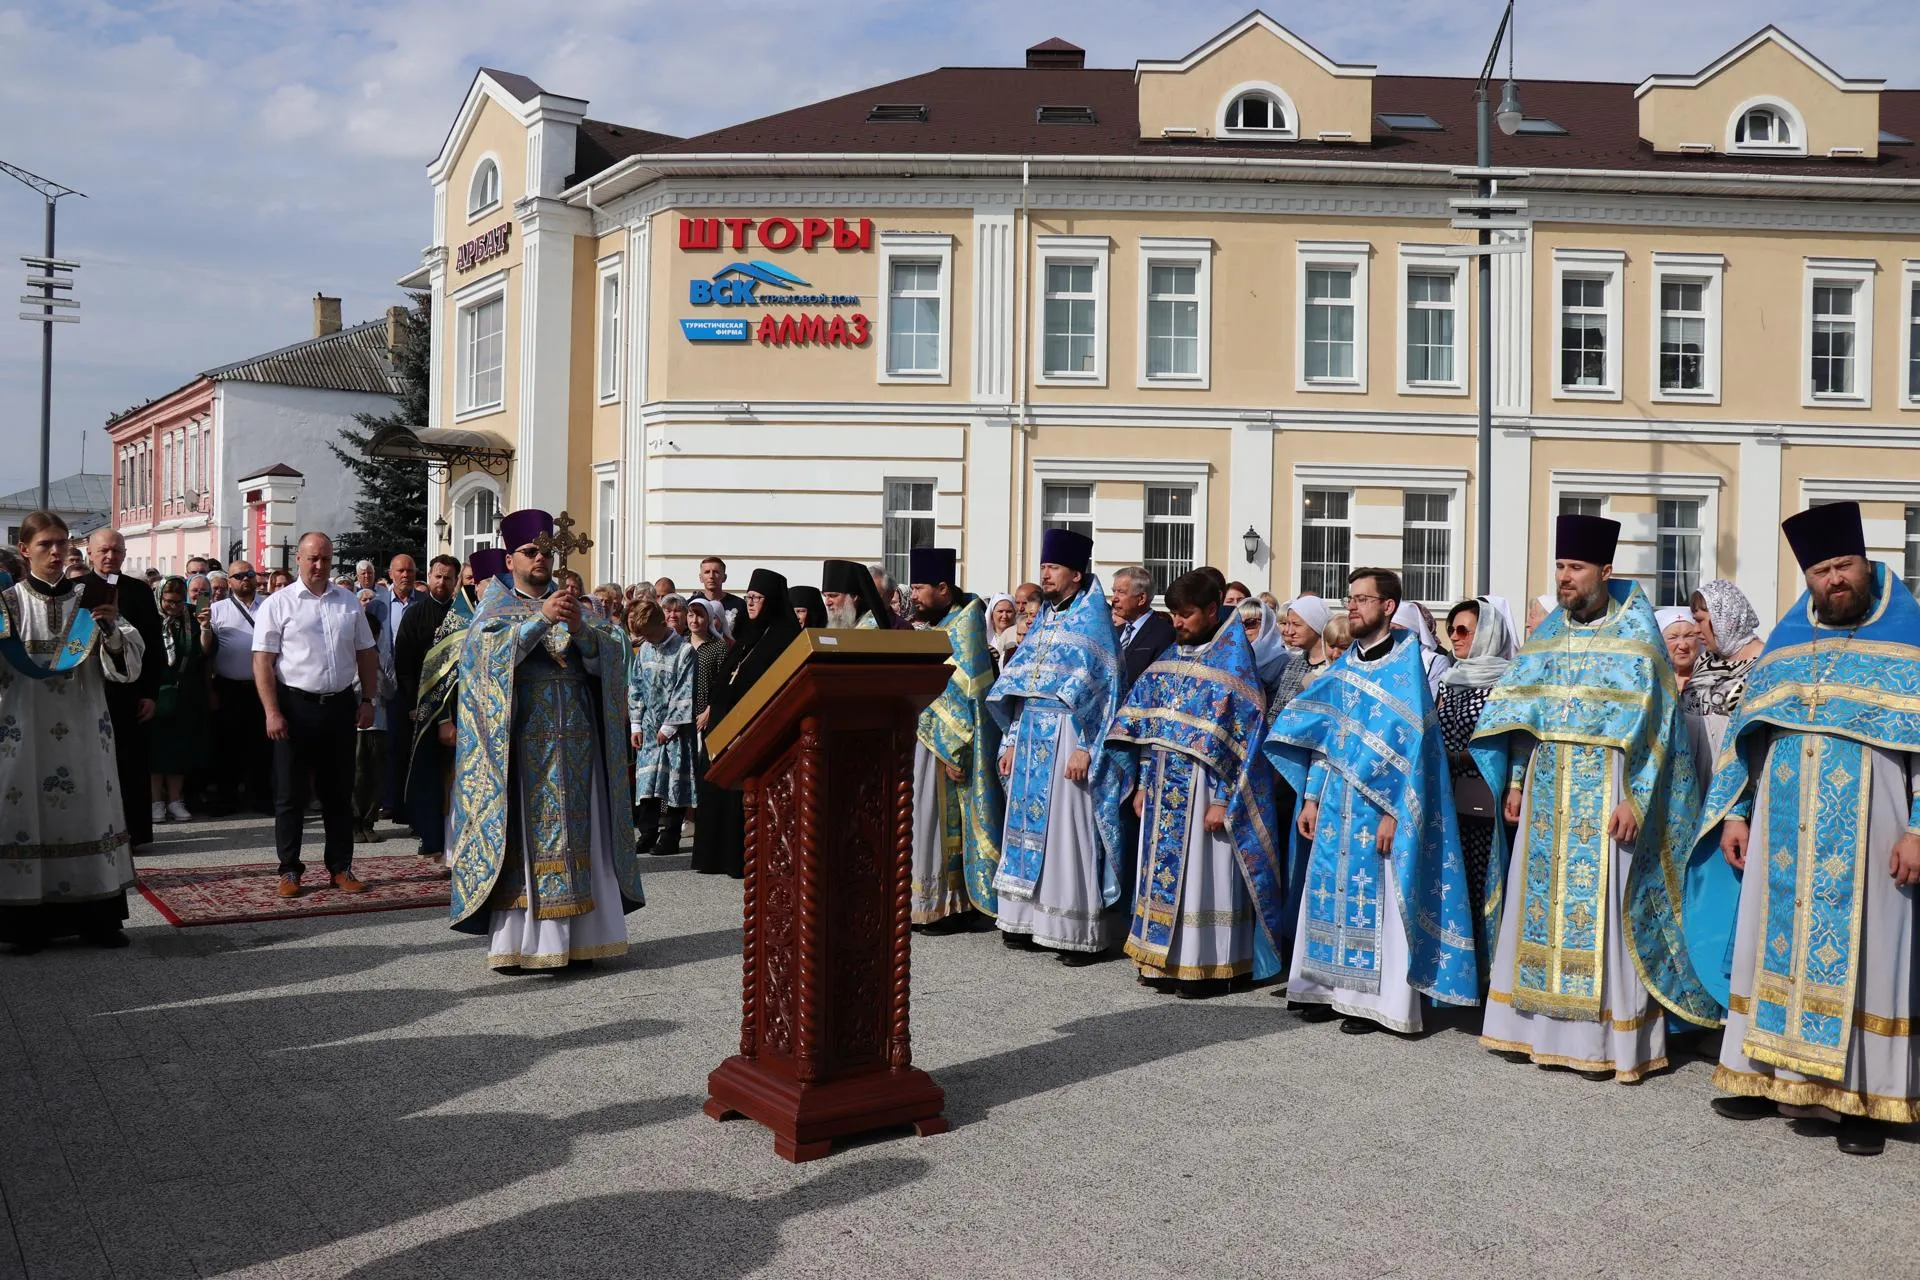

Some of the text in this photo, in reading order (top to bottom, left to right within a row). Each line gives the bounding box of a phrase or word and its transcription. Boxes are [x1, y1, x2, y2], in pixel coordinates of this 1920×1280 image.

[456, 222, 509, 272] АРБАТ
[679, 217, 872, 249] ШТОРЫ
[690, 279, 757, 304] ВСК
[760, 294, 859, 305] СТРАХОВОЙ ДОМ
[756, 312, 868, 345] АЛМАЗ
